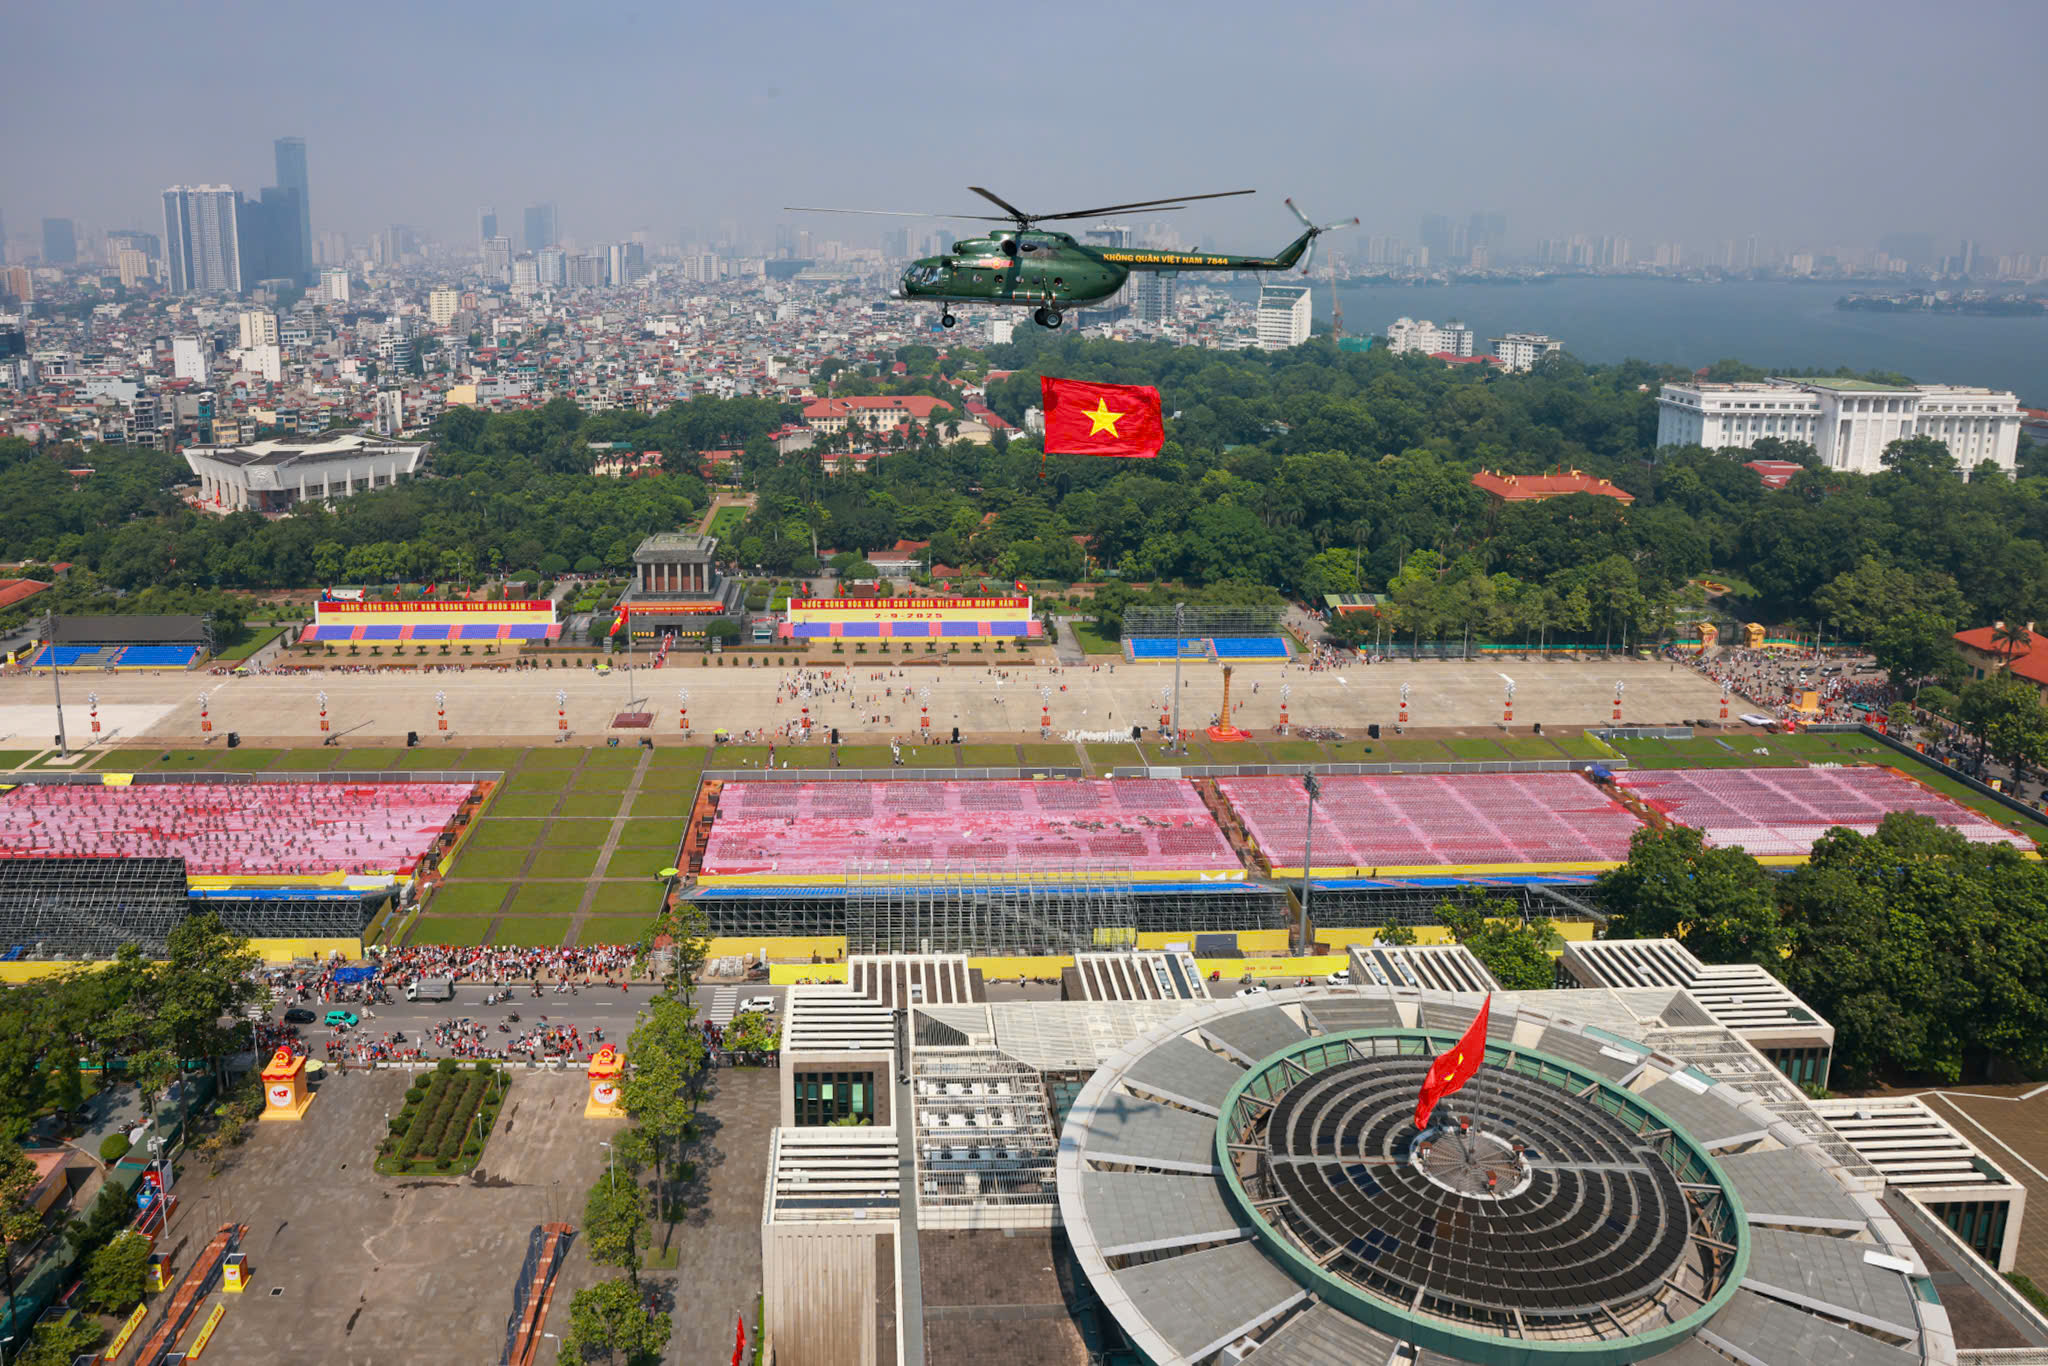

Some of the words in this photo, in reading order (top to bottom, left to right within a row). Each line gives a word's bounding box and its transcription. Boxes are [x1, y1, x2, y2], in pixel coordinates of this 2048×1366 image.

[1103, 253, 1133, 262] KHÔNG
[1135, 253, 1160, 263] QUÂN
[1161, 254, 1180, 264] VIỆT
[1182, 256, 1203, 264] NAM
[1207, 257, 1228, 265] 7844
